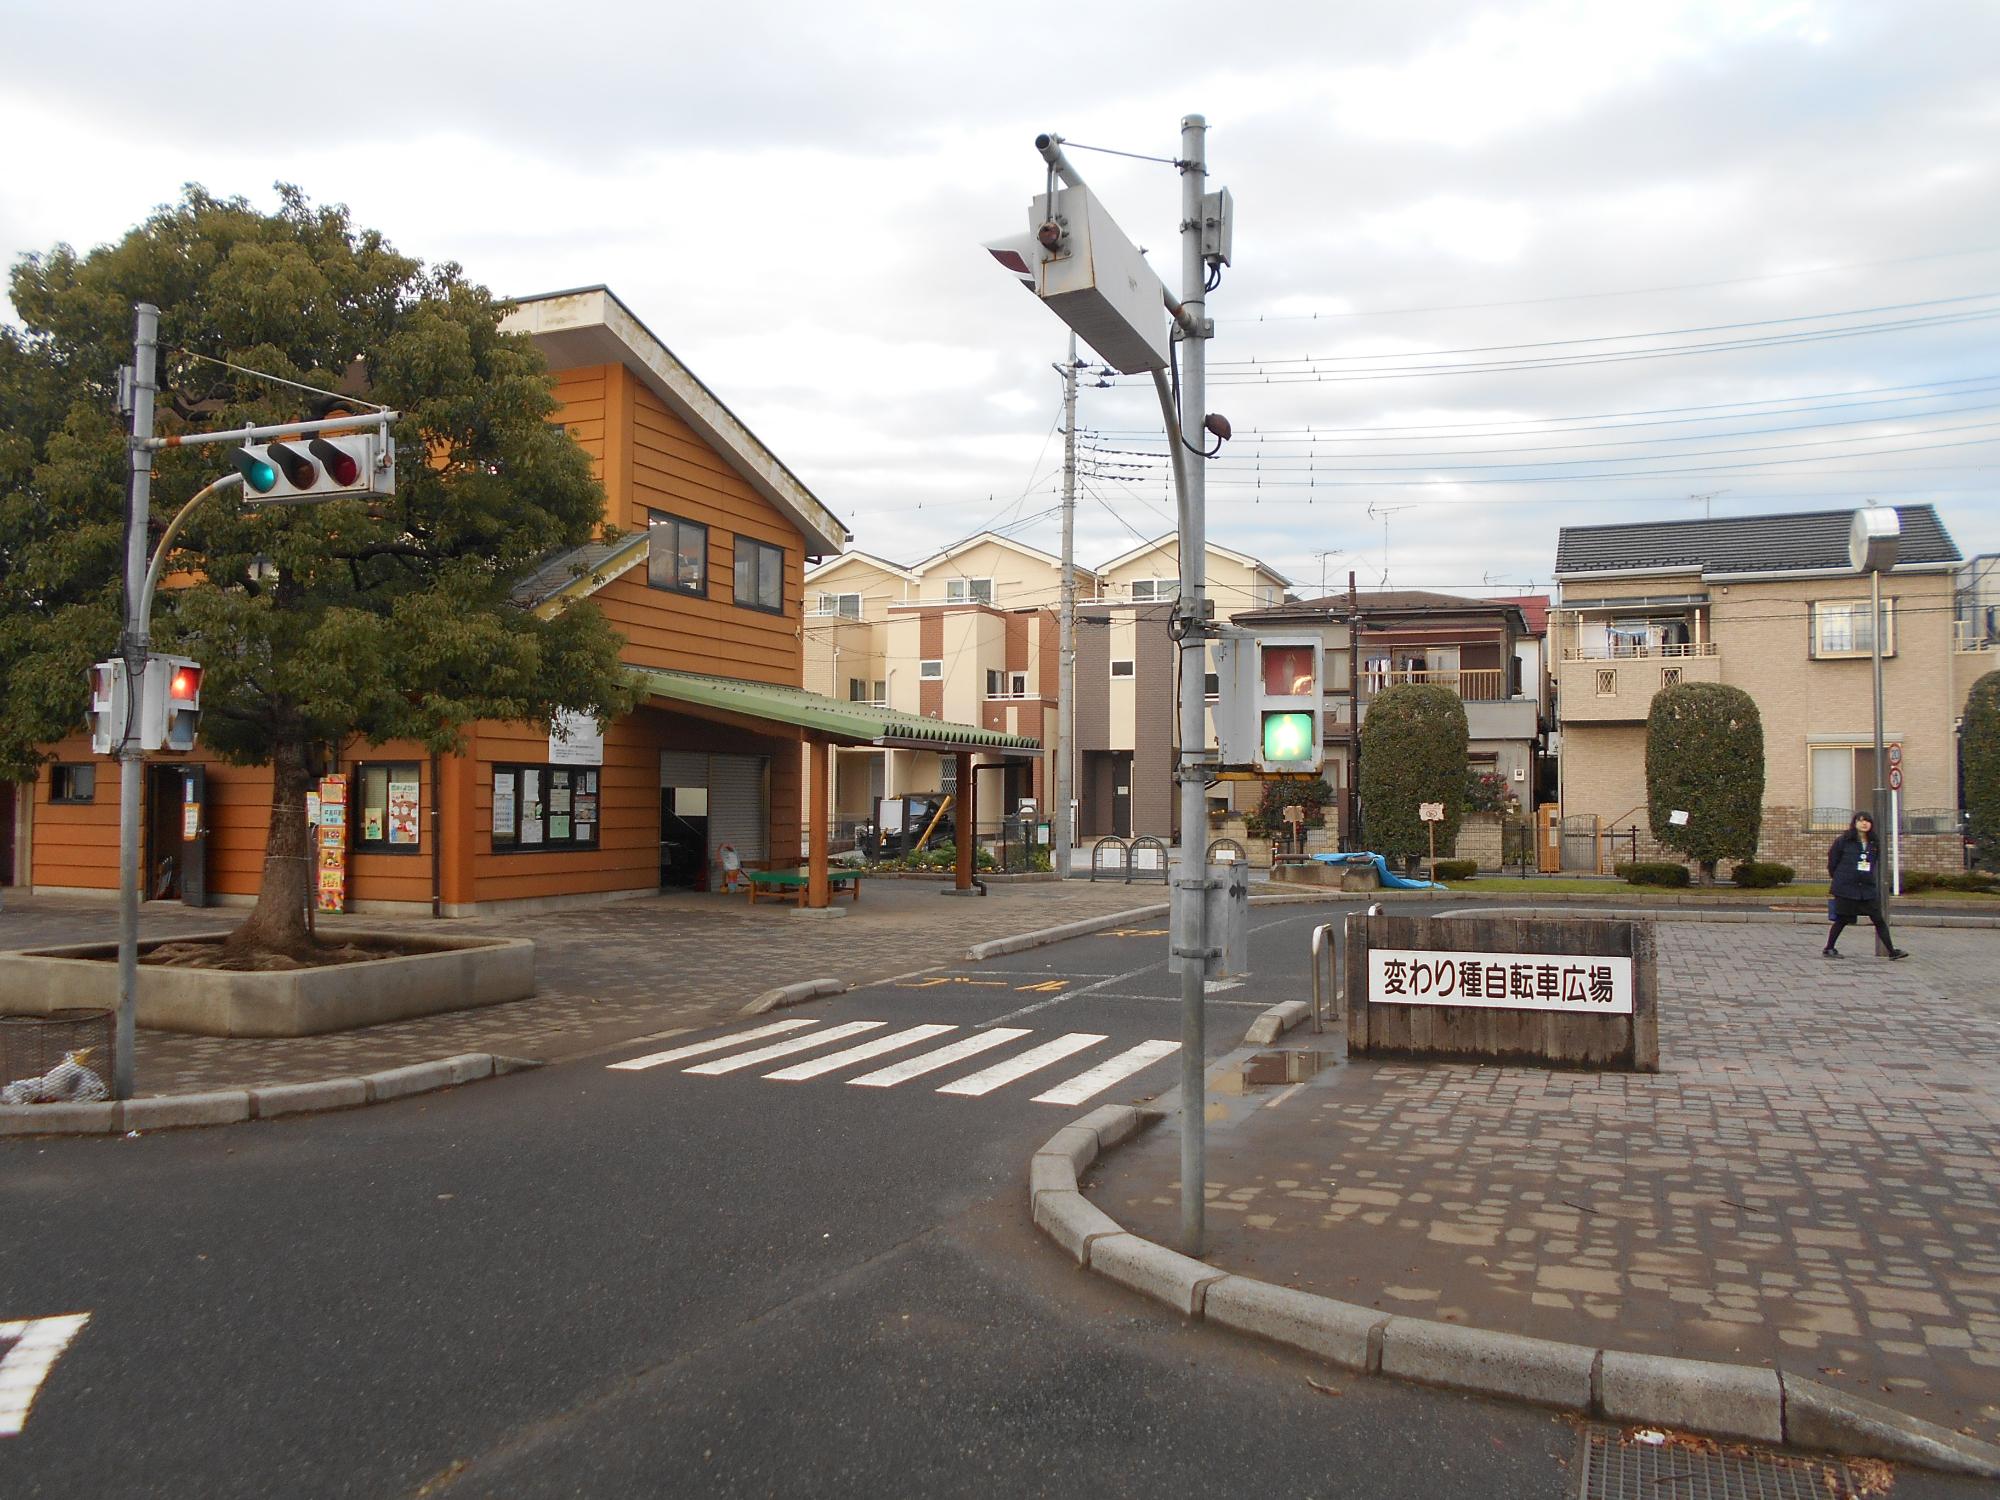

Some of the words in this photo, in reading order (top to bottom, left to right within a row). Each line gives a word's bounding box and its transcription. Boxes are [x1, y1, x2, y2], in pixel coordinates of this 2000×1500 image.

[1384, 958, 1614, 1003] 変わり種自転車広場
